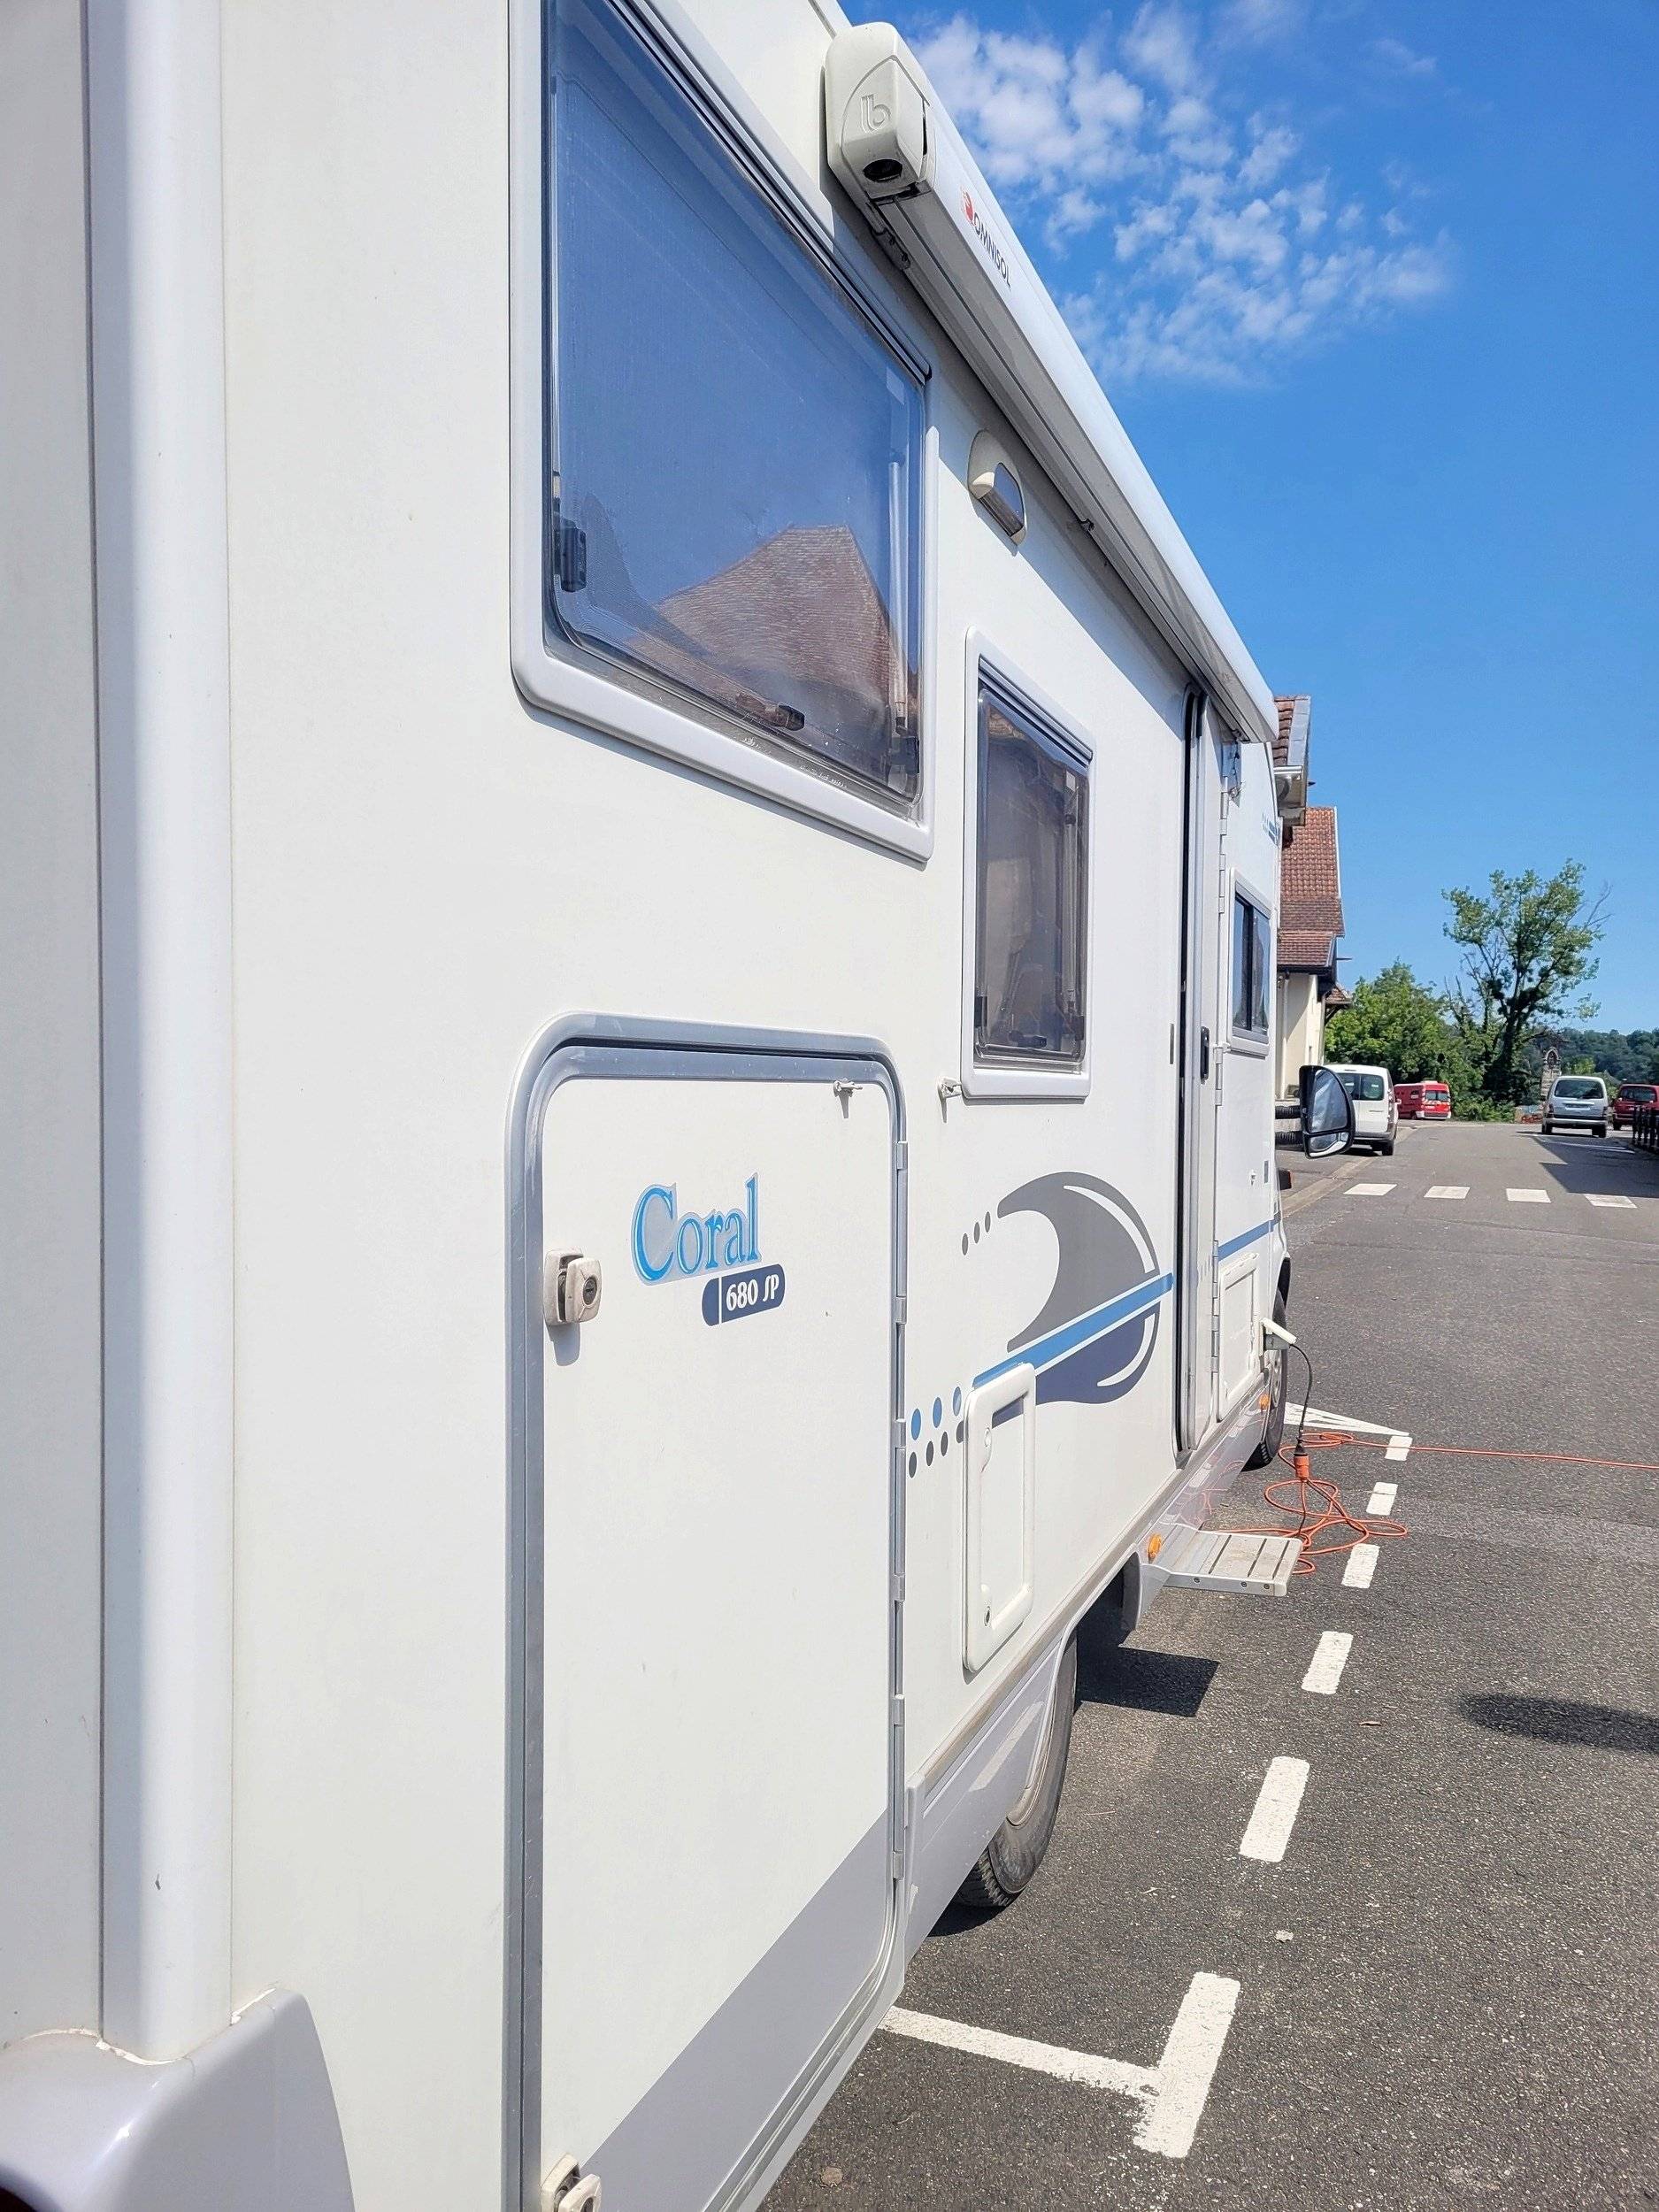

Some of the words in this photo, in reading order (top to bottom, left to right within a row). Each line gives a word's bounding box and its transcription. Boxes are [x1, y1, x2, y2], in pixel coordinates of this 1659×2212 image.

[973, 211, 1011, 290] OMNISOL
[632, 1172, 761, 1284] Coral
[725, 1280, 758, 1312] 680
[763, 1274, 780, 1302] SP
